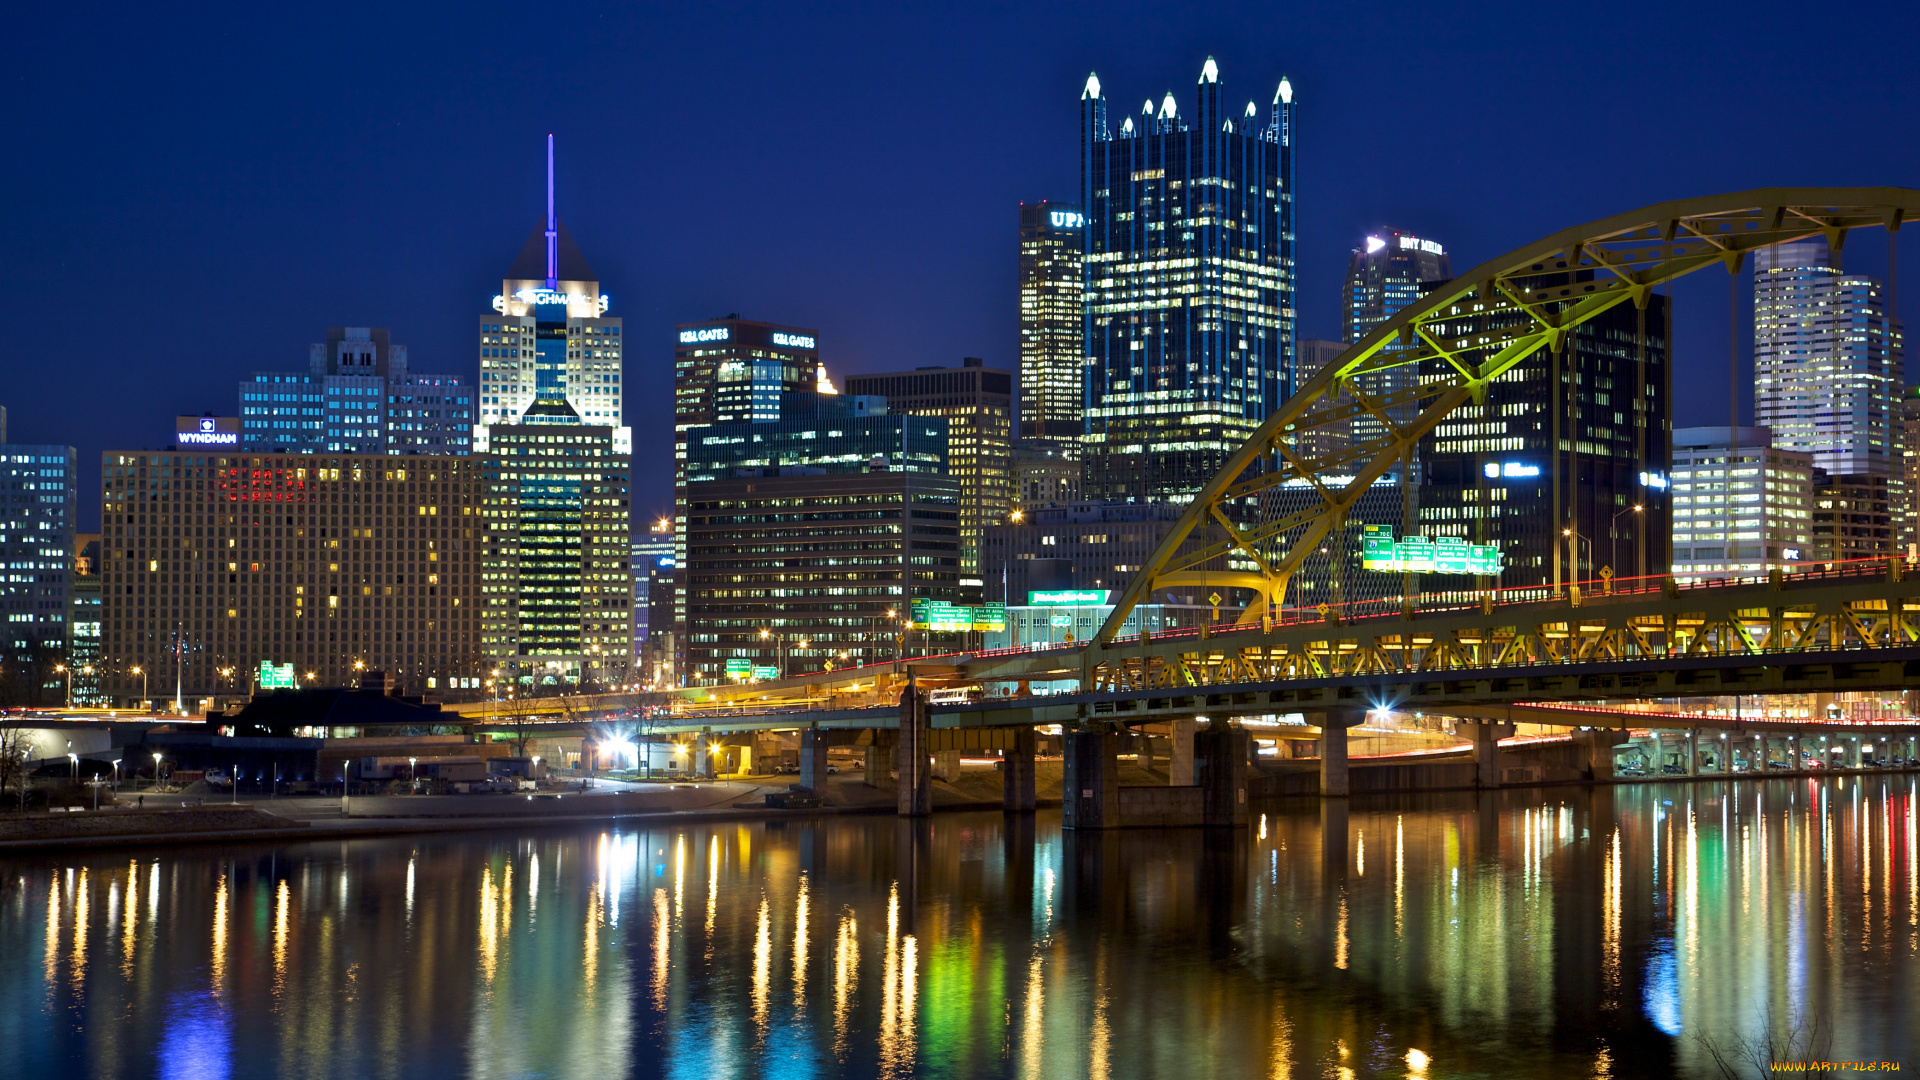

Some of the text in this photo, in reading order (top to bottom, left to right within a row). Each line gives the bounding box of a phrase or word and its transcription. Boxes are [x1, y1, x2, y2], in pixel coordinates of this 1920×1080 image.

[698, 327, 729, 341] GATES
[789, 335, 815, 349] GATES
[178, 432, 237, 444] WYNDHAM
